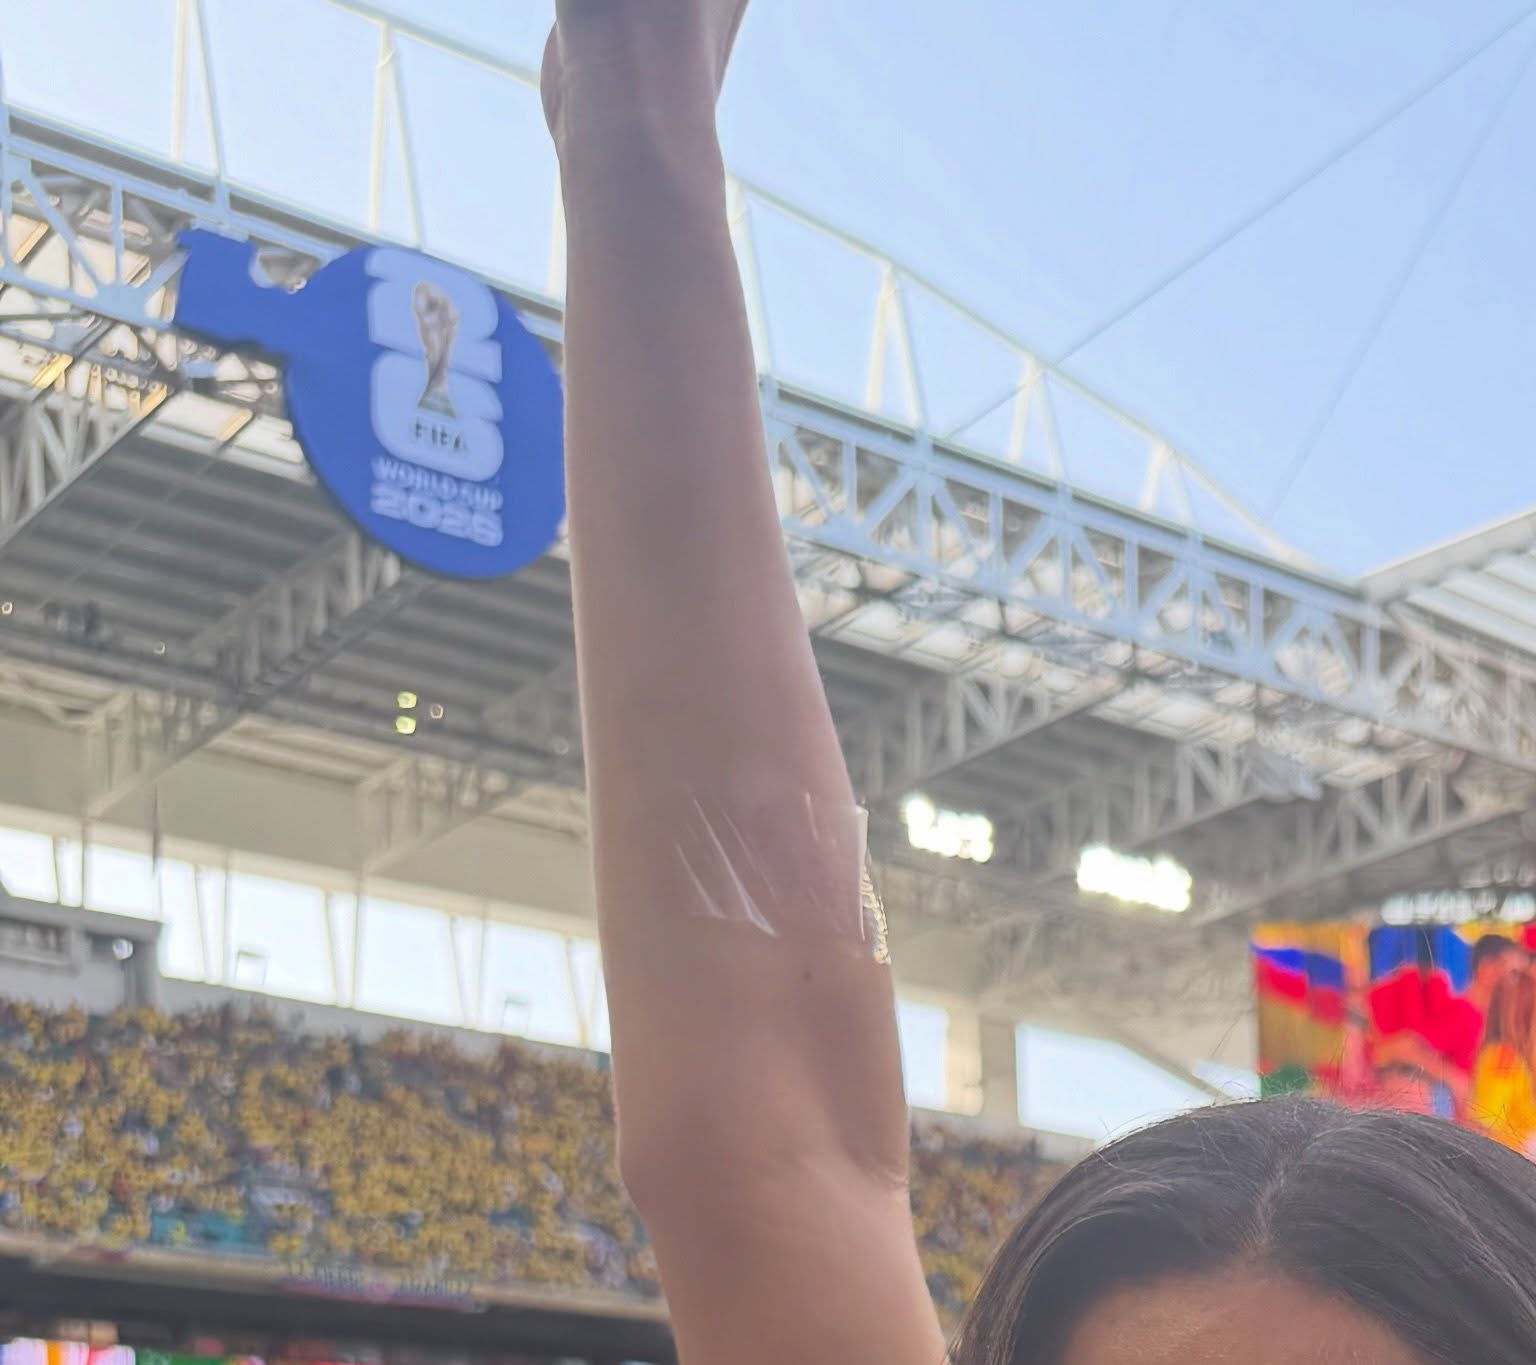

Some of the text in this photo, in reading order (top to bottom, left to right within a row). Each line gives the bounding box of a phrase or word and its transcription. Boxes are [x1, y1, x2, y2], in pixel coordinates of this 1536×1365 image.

[414, 420, 468, 453] FIFA
[370, 456, 504, 512] WORLD CUP
